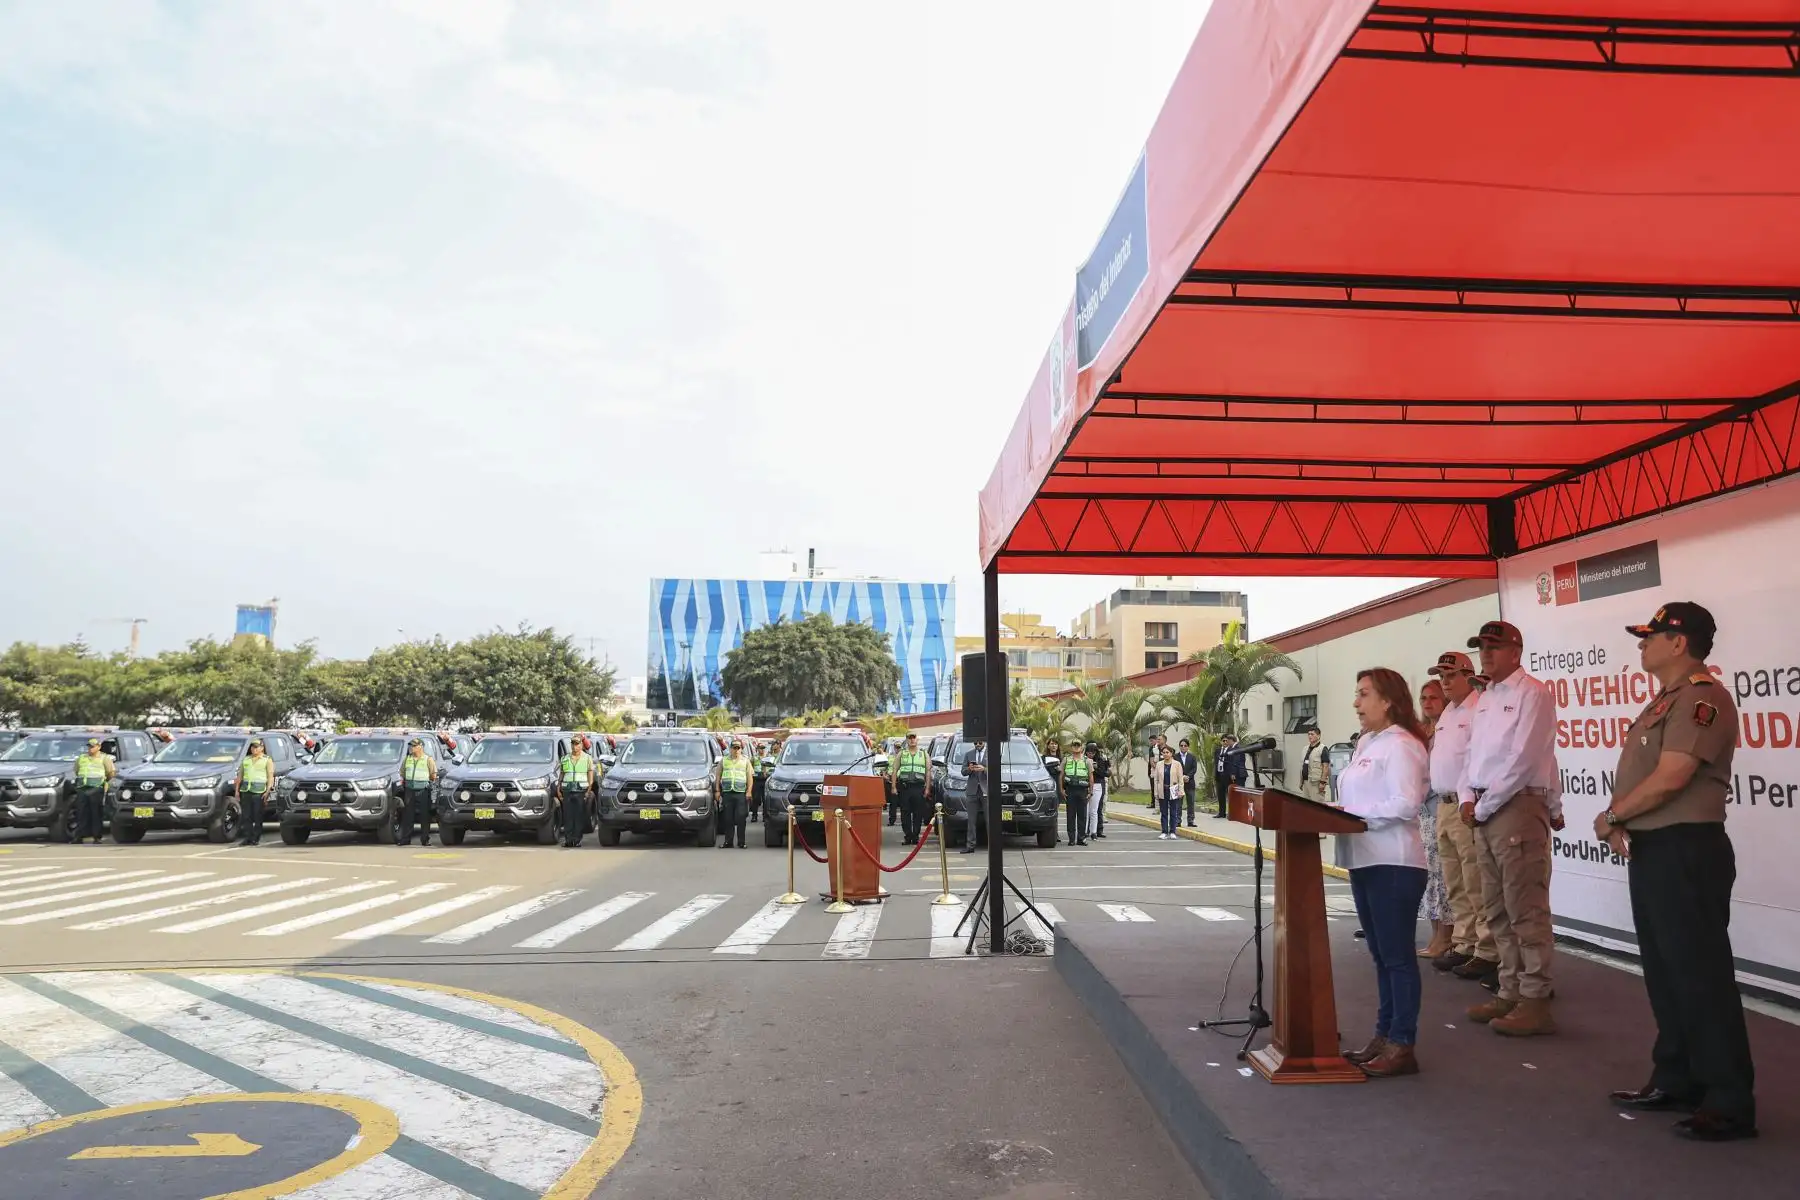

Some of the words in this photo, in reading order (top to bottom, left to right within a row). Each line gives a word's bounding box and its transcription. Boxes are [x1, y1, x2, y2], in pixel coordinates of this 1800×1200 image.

[1076, 288, 1099, 336] nisterio
[1099, 271, 1110, 302] del
[1109, 231, 1132, 287] Interior
[1556, 574, 1576, 591] PERÚ
[1580, 569, 1611, 585] Ministerio
[1611, 565, 1622, 577] del
[1622, 560, 1647, 575] Interior
[1530, 650, 1584, 674] Entrega
[1587, 644, 1607, 666] de
[1734, 666, 1800, 708] para
[1560, 767, 1597, 796] licía
[1725, 773, 1742, 805] el
[1748, 774, 1800, 809] Per
